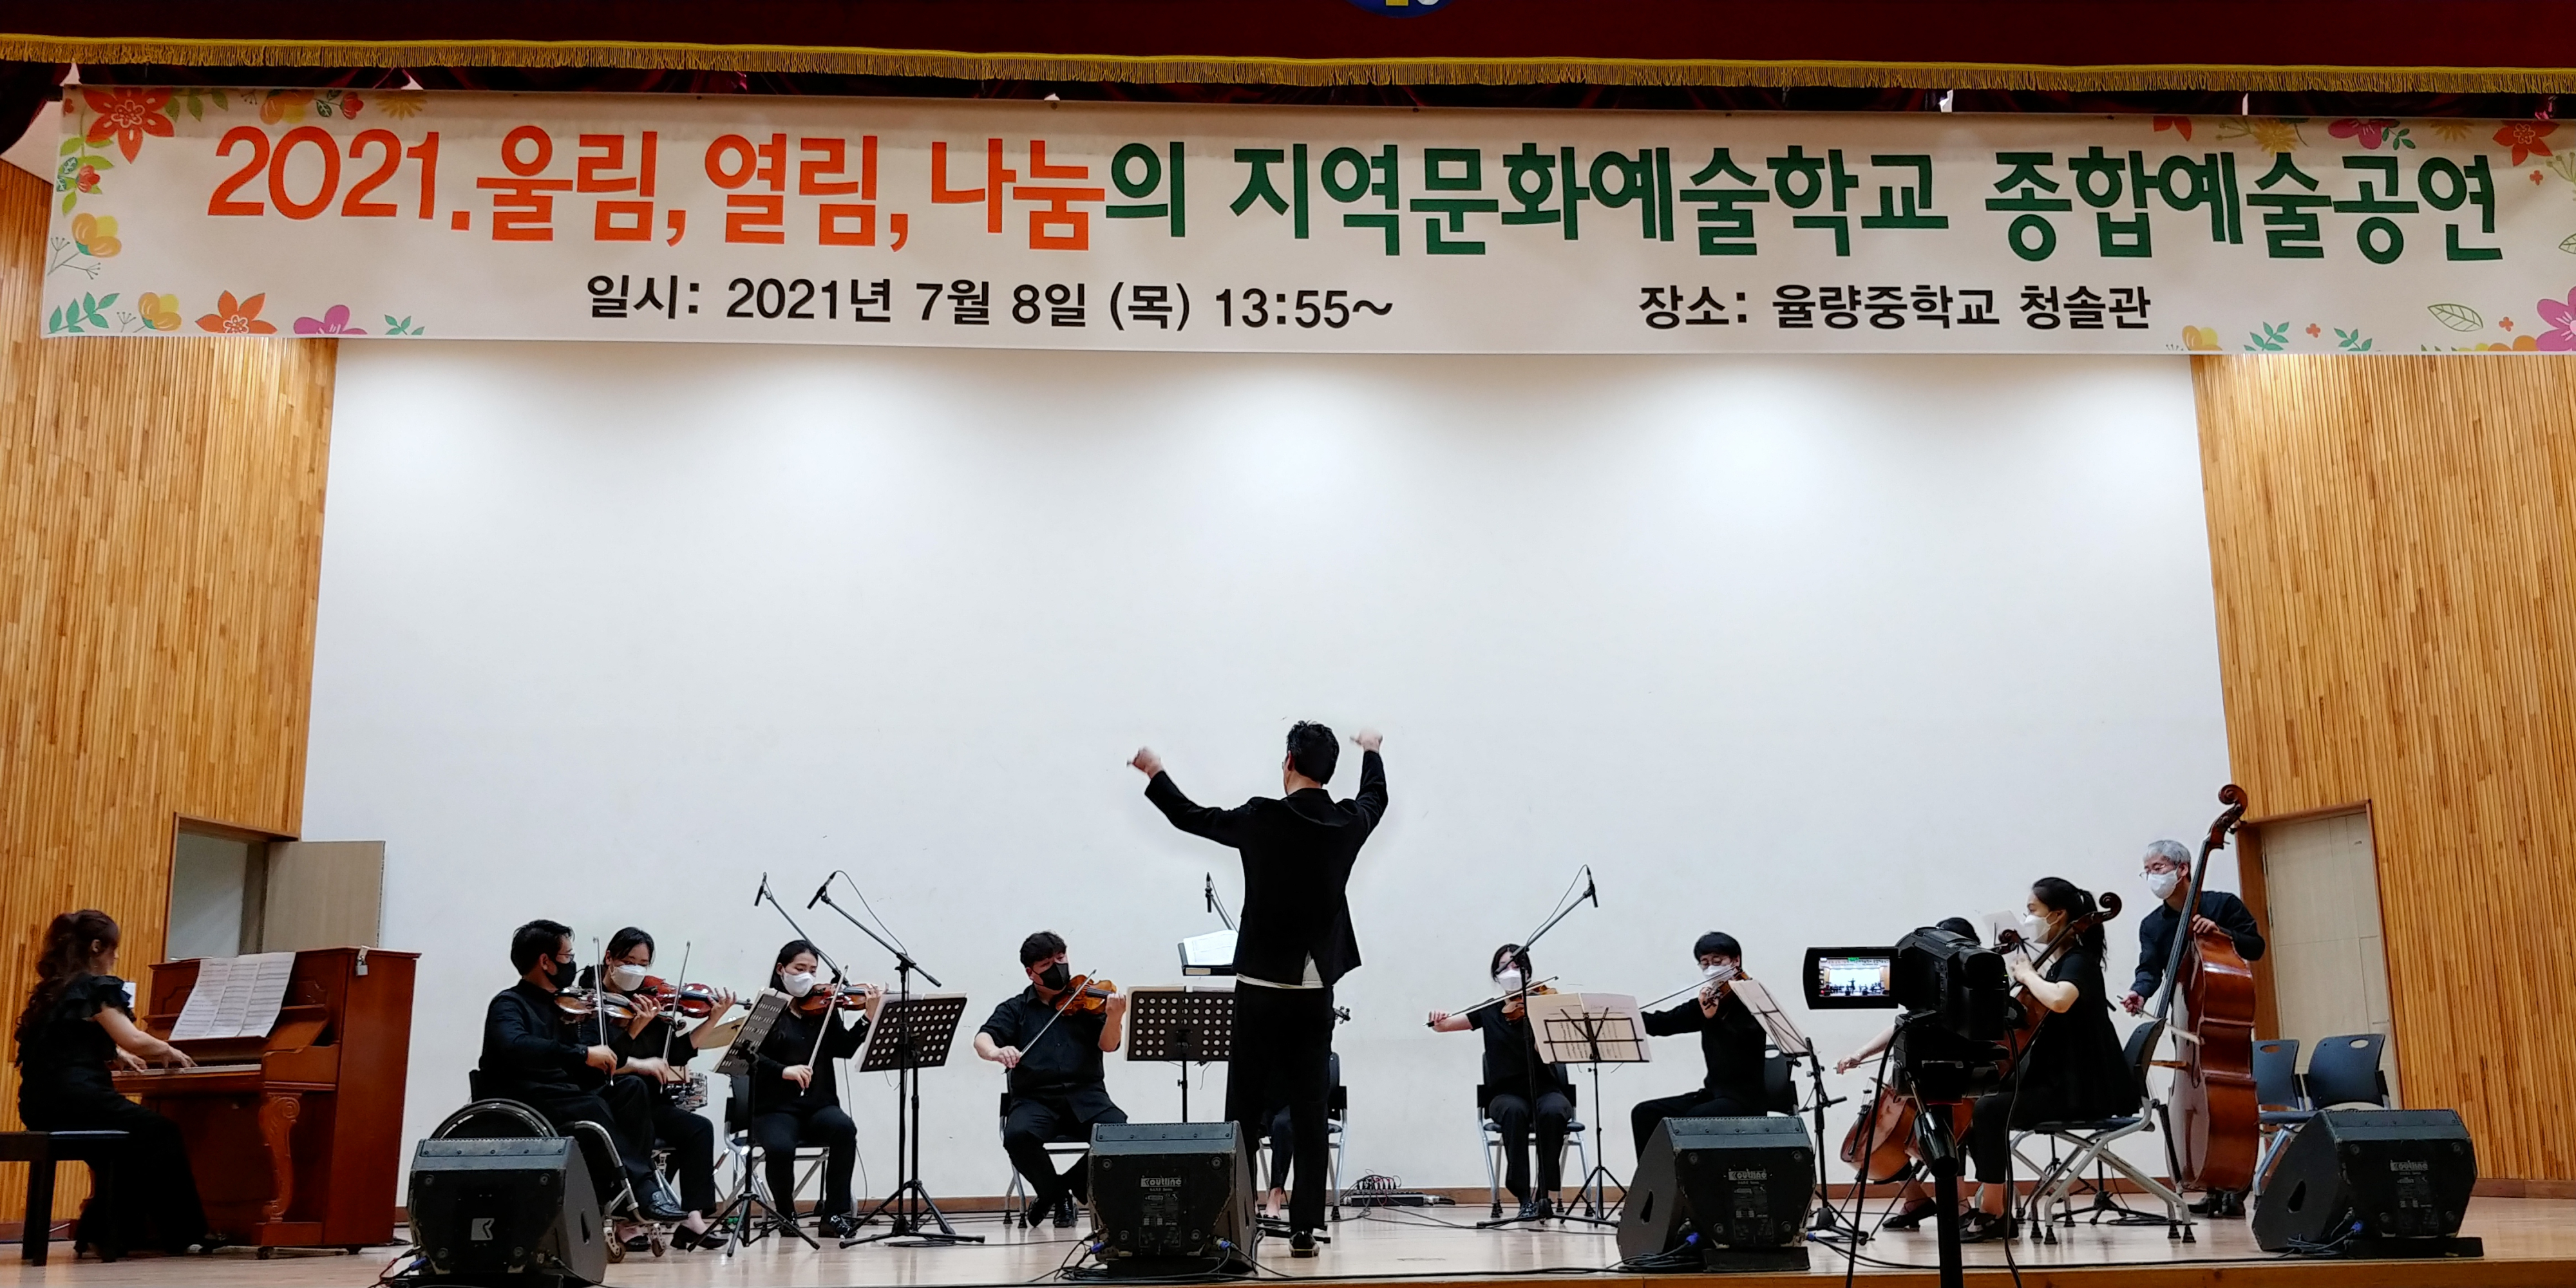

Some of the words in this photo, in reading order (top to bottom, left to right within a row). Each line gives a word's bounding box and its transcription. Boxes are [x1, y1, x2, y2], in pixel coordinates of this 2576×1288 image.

[705, 133, 909, 252] 열림,
[931, 138, 1184, 251] 나눔의
[1230, 143, 1949, 256] 지역문화예술학교
[1985, 146, 2503, 264] 종합예술공연
[587, 274, 699, 319] 일시:
[727, 278, 891, 323] 2021년
[916, 279, 990, 325] 7월
[1012, 282, 1086, 327] 8일
[1110, 282, 1189, 331] (목)
[1215, 289, 1393, 329] 13:55~
[1639, 284, 1747, 330] 장소:
[1772, 284, 2000, 330] 율량중학교
[2019, 285, 2151, 330] 청솔관
